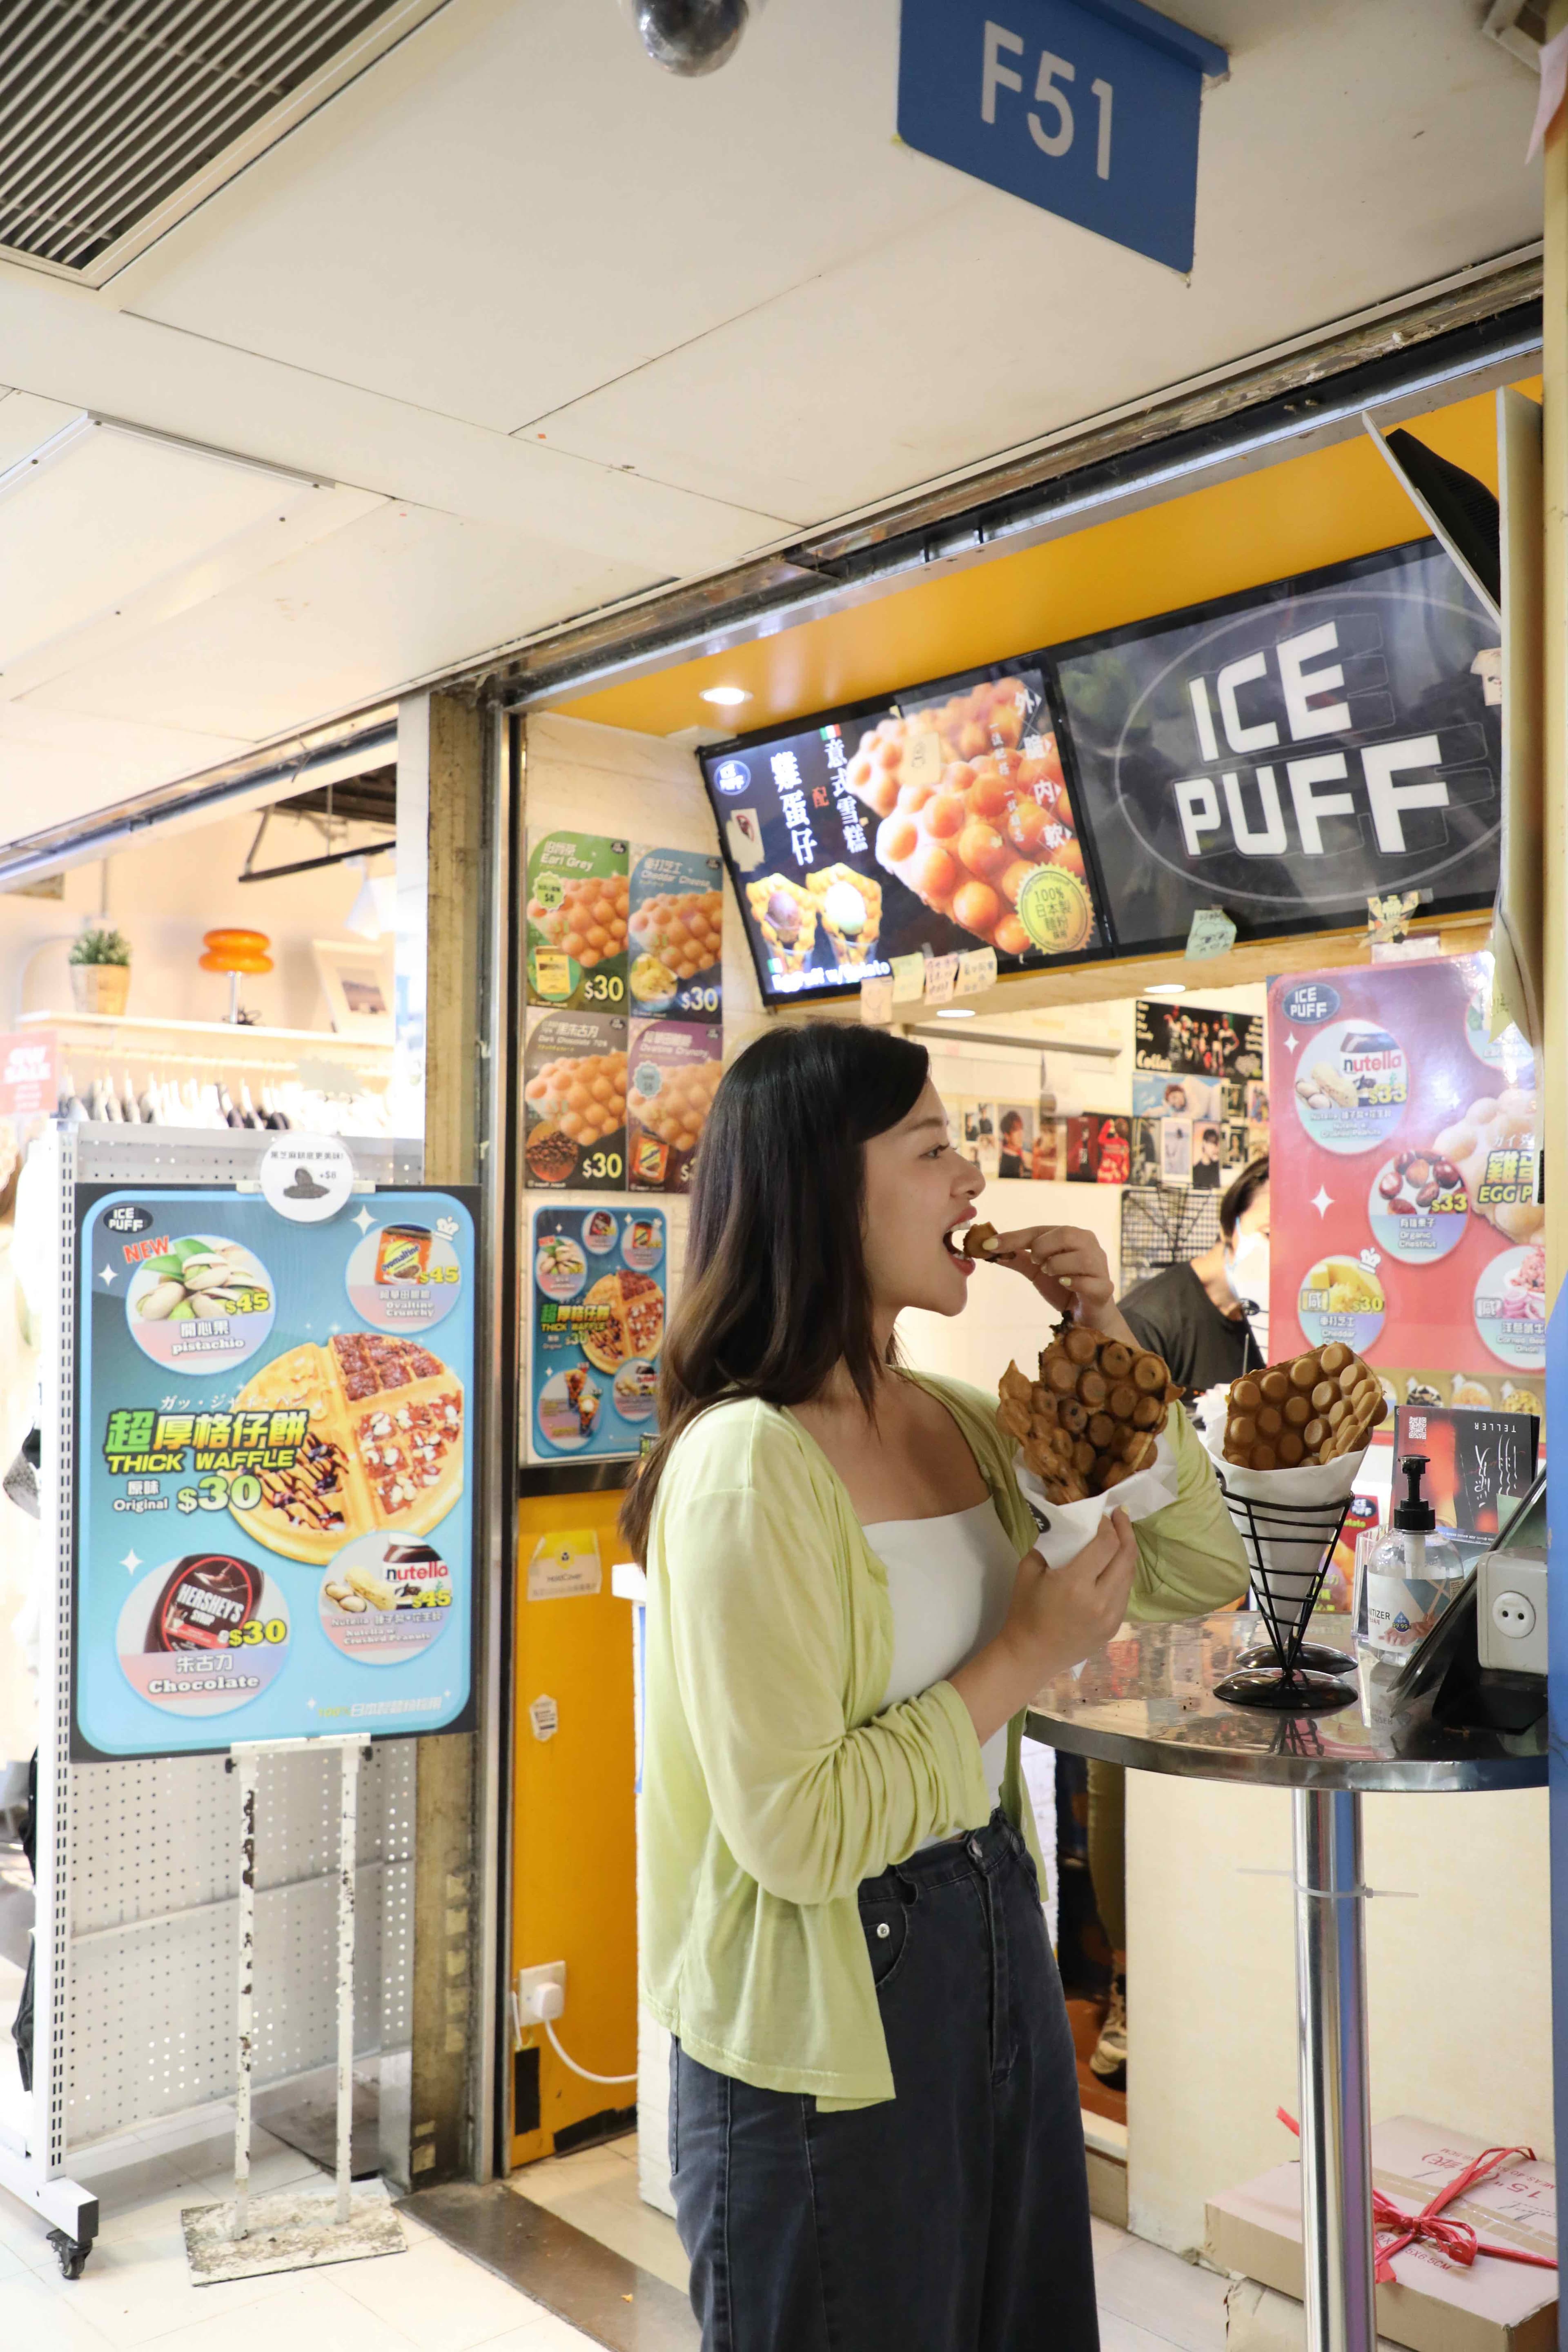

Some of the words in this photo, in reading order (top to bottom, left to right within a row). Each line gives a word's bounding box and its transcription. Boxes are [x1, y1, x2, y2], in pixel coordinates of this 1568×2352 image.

[981, 20, 1113, 181] F51
[1187, 621, 1352, 762] ICE
[812, 786, 830, 808] 配
[824, 739, 868, 854] 意式雪糕
[1174, 735, 1450, 856] PUFF
[541, 852, 565, 865] Earl
[566, 857, 594, 872] Grey
[584, 974, 624, 1002] $30
[1294, 986, 1317, 1003] ICE
[681, 986, 719, 1011] $30
[1290, 1001, 1327, 1018] PUFF
[1344, 1050, 1402, 1073] nutella
[1368, 1083, 1408, 1105] $33
[582, 1152, 622, 1178] $30
[1431, 1193, 1468, 1212] $33
[1479, 1185, 1517, 1203] EGG
[113, 1207, 135, 1219] ICE
[108, 1219, 143, 1232] PUFF
[1400, 1231, 1431, 1240] Organic
[123, 1235, 169, 1264] NEW
[419, 1266, 459, 1284] $45
[225, 1292, 270, 1315] $45
[386, 1301, 434, 1310] Ovaltine
[386, 1309, 434, 1317] Crunchy
[1352, 1296, 1383, 1312] $30
[180, 1319, 230, 1338] 開心果
[1322, 1329, 1356, 1337] Cheddar
[171, 1338, 245, 1356] pistachio
[105, 1410, 308, 1454] 超厚格仔餅
[1474, 1422, 1517, 1433] TELLER
[106, 1453, 185, 1474] THICK
[195, 1448, 296, 1471] WAFFLE
[127, 1479, 160, 1496] 原味
[177, 1474, 263, 1515] $30
[113, 1497, 169, 1515] Original
[386, 1560, 449, 1582] nutella
[176, 1583, 245, 1624] HERSHEY'S
[412, 1588, 453, 1609] $45
[228, 1618, 287, 1647] $30
[332, 1618, 370, 1627] Nutella
[343, 1635, 387, 1645] Crushed
[389, 1633, 432, 1642] Peanuts
[175, 1653, 234, 1674] 朱古力
[148, 1675, 260, 1694] Chocolate
